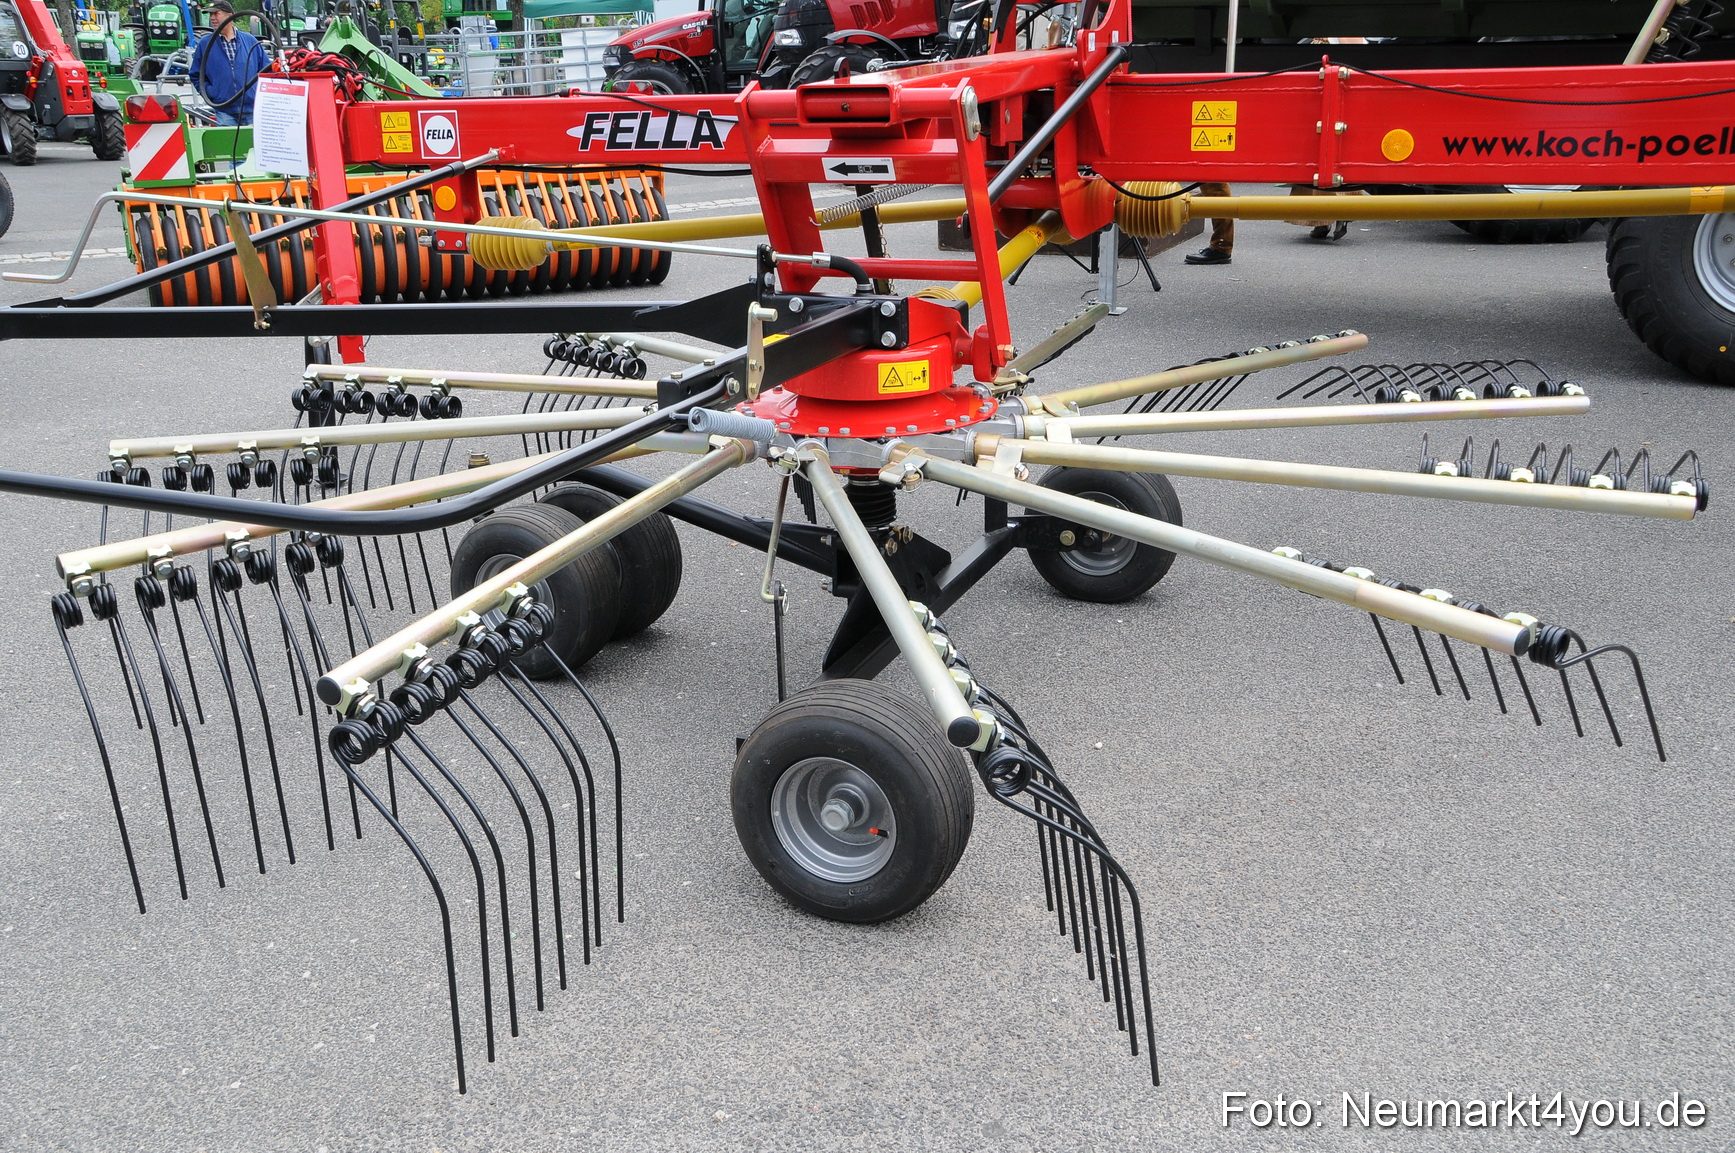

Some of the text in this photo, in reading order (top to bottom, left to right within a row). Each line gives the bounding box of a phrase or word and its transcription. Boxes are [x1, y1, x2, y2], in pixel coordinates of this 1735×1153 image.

[15, 43, 26, 56] 20
[632, 39, 644, 48] 95
[426, 129, 454, 140] FELLA
[579, 110, 727, 150] FELLA
